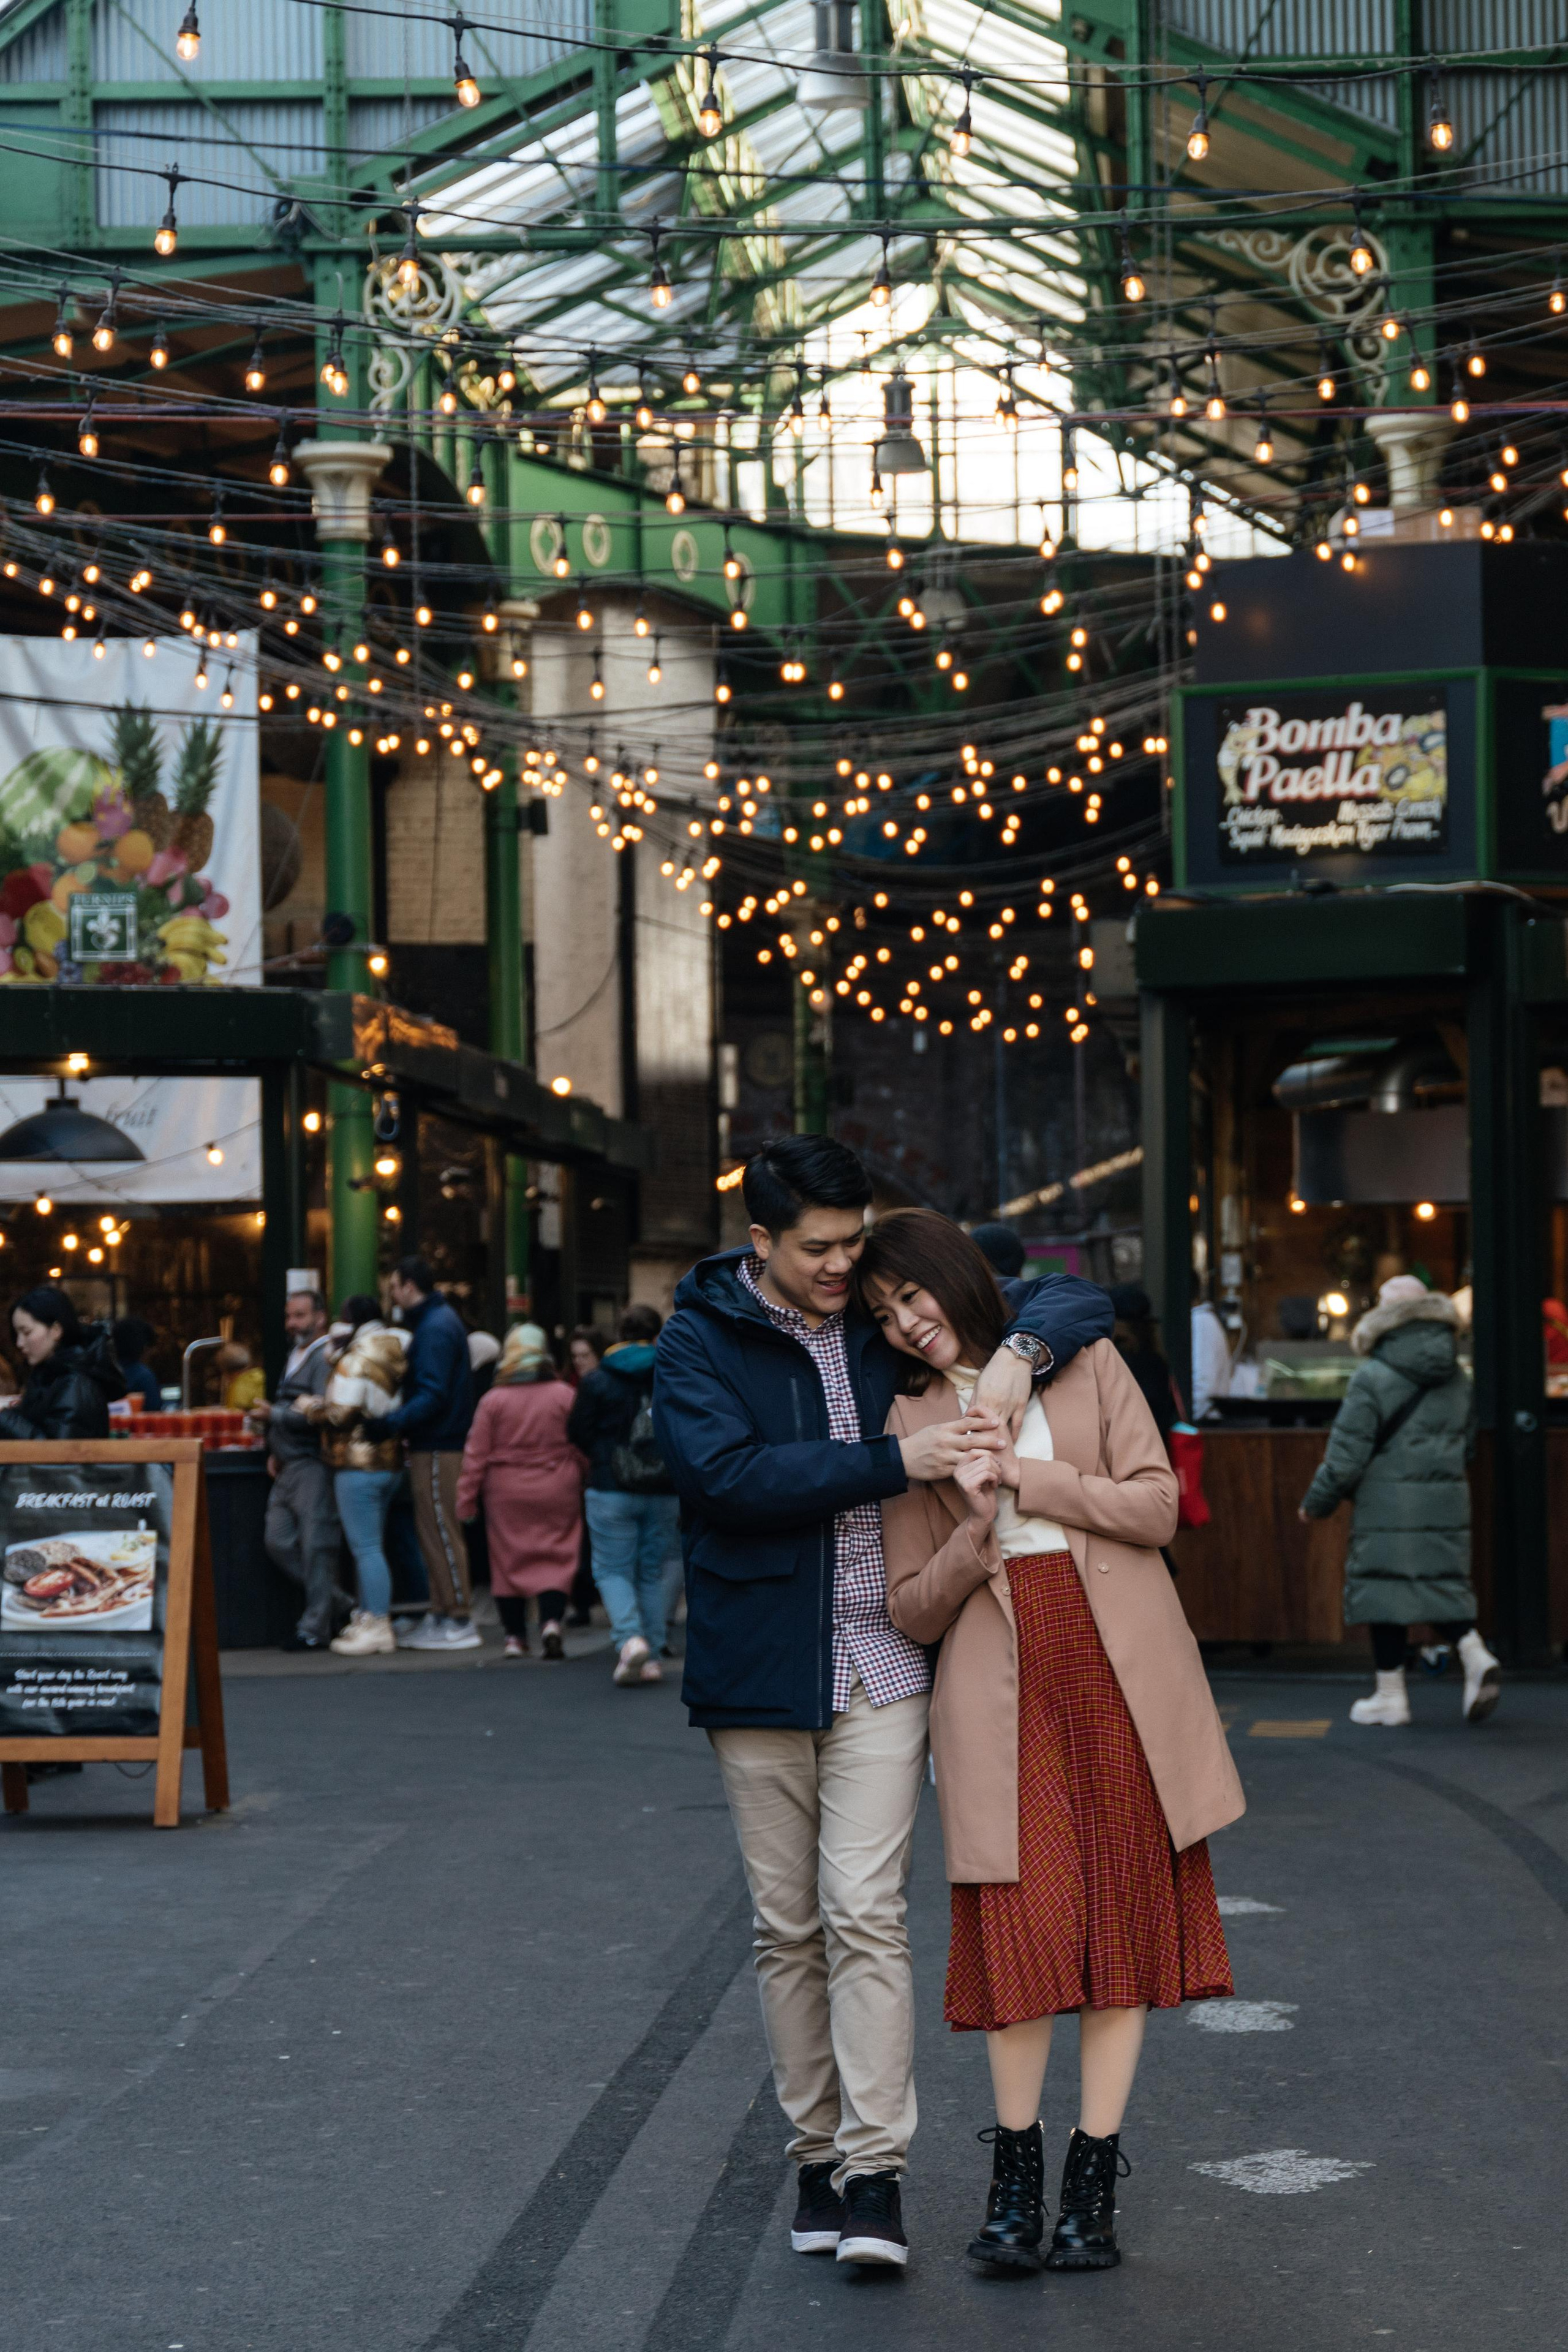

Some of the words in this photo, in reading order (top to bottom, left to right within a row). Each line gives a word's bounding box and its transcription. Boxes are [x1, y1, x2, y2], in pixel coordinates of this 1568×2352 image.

[1245, 701, 1403, 755] Bomba
[1244, 750, 1381, 804] Paella
[15, 1492, 98, 1509] BREAKFAST
[96, 1493, 110, 1508] at
[111, 1491, 157, 1509] ROAST
